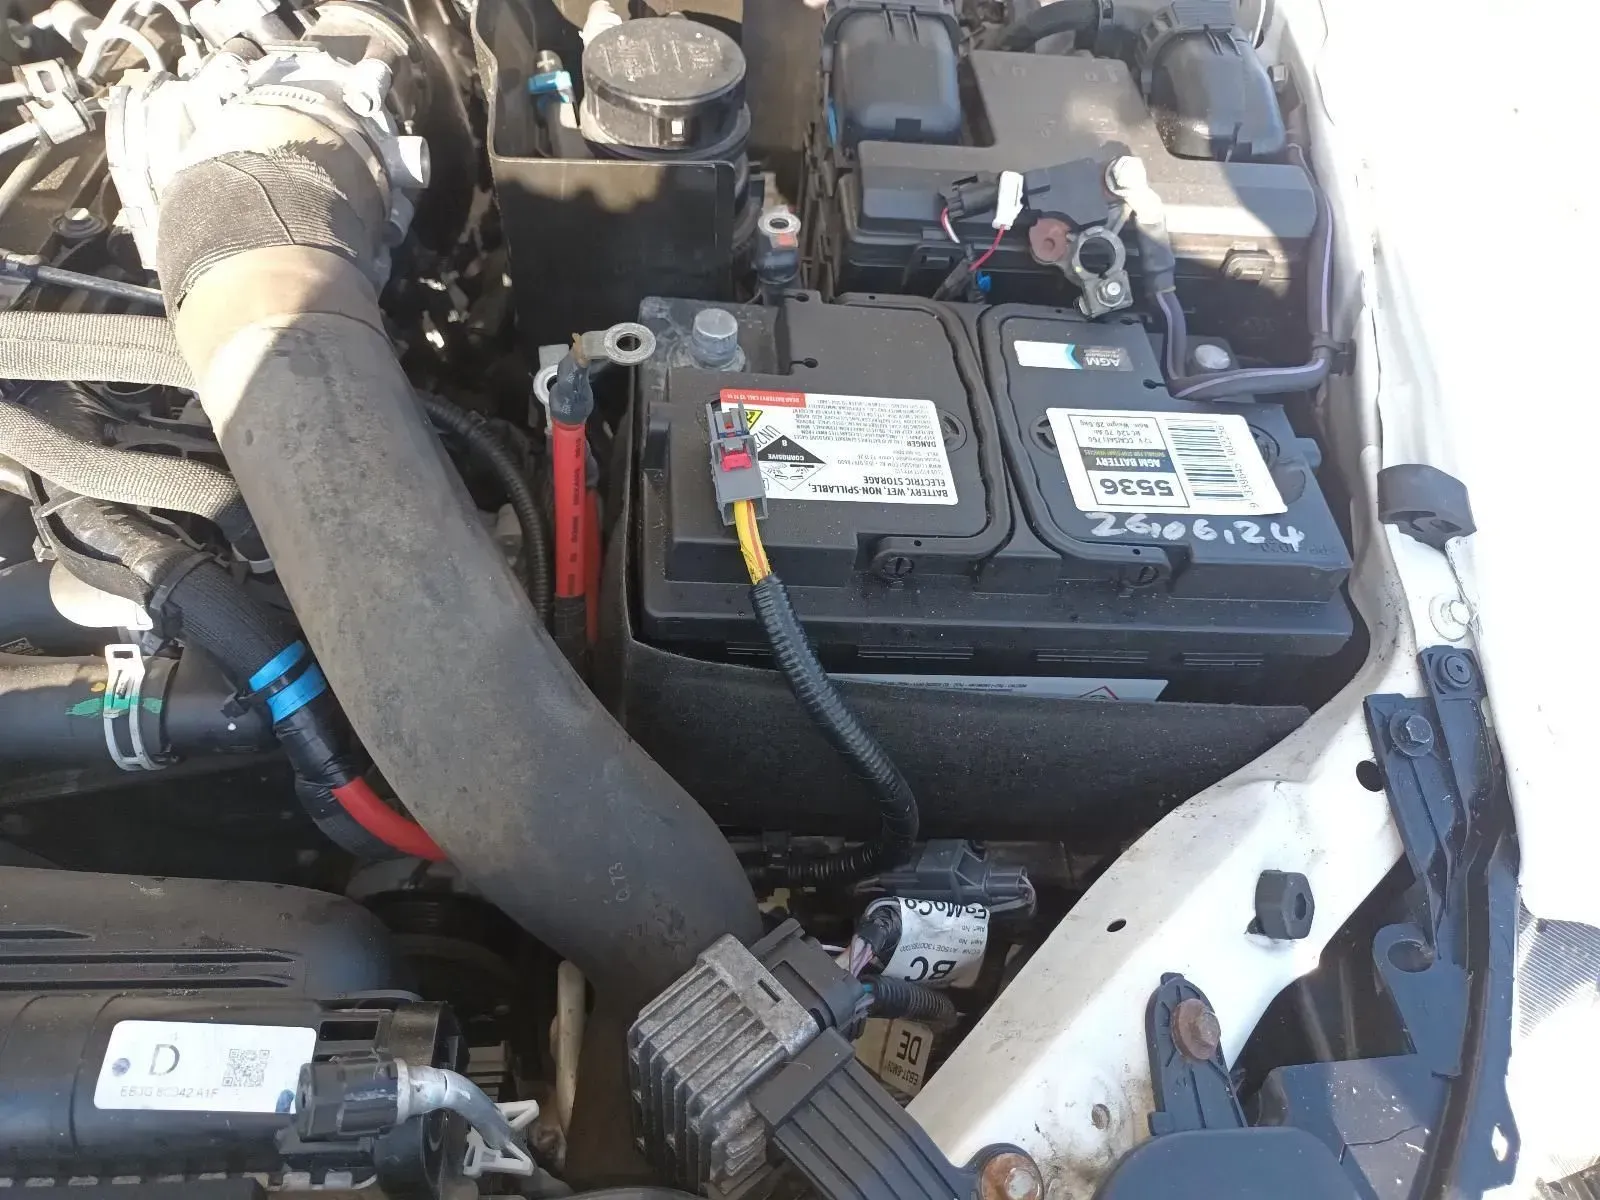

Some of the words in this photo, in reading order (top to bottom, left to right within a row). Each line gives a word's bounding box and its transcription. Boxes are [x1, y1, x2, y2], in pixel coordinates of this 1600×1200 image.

[1086, 357, 1120, 367] AGM
[781, 439, 788, 447] 8
[906, 440, 937, 448] DANGER
[767, 453, 805, 461] CORROSIVE
[1095, 456, 1138, 467] BATTERY
[1138, 458, 1161, 468] AGM
[863, 476, 904, 486] STORAGE
[904, 476, 946, 487] ELECTRIC
[808, 483, 882, 495] NON-SPILLABLE,
[883, 487, 906, 496] WET,
[1100, 478, 1174, 497] 5536
[906, 488, 949, 498] BATTERY,
[904, 956, 957, 982] BC
[896, 1029, 922, 1065] DE
[148, 1043, 180, 1076] D
